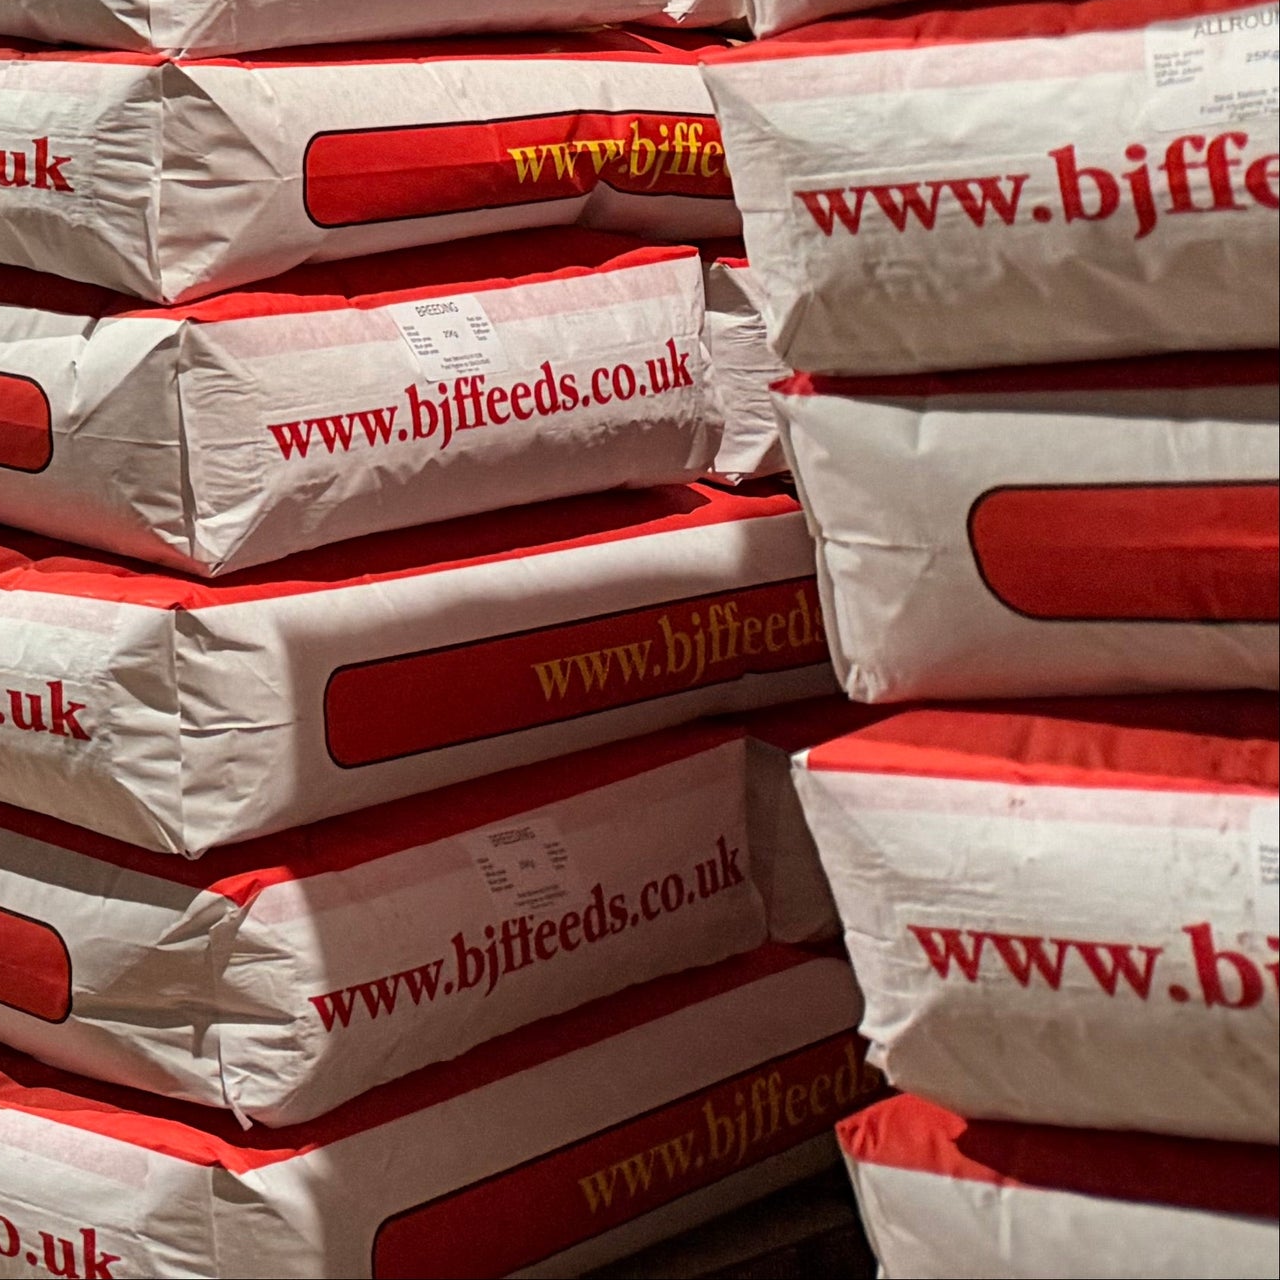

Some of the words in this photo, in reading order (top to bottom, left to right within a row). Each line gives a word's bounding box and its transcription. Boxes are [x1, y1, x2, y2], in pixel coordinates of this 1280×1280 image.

[508, 121, 731, 188] www.bjffe
[268, 337, 693, 461] www.bjffeeds.co.uk
[310, 836, 746, 1032] www.bjffeeds.co.uk
